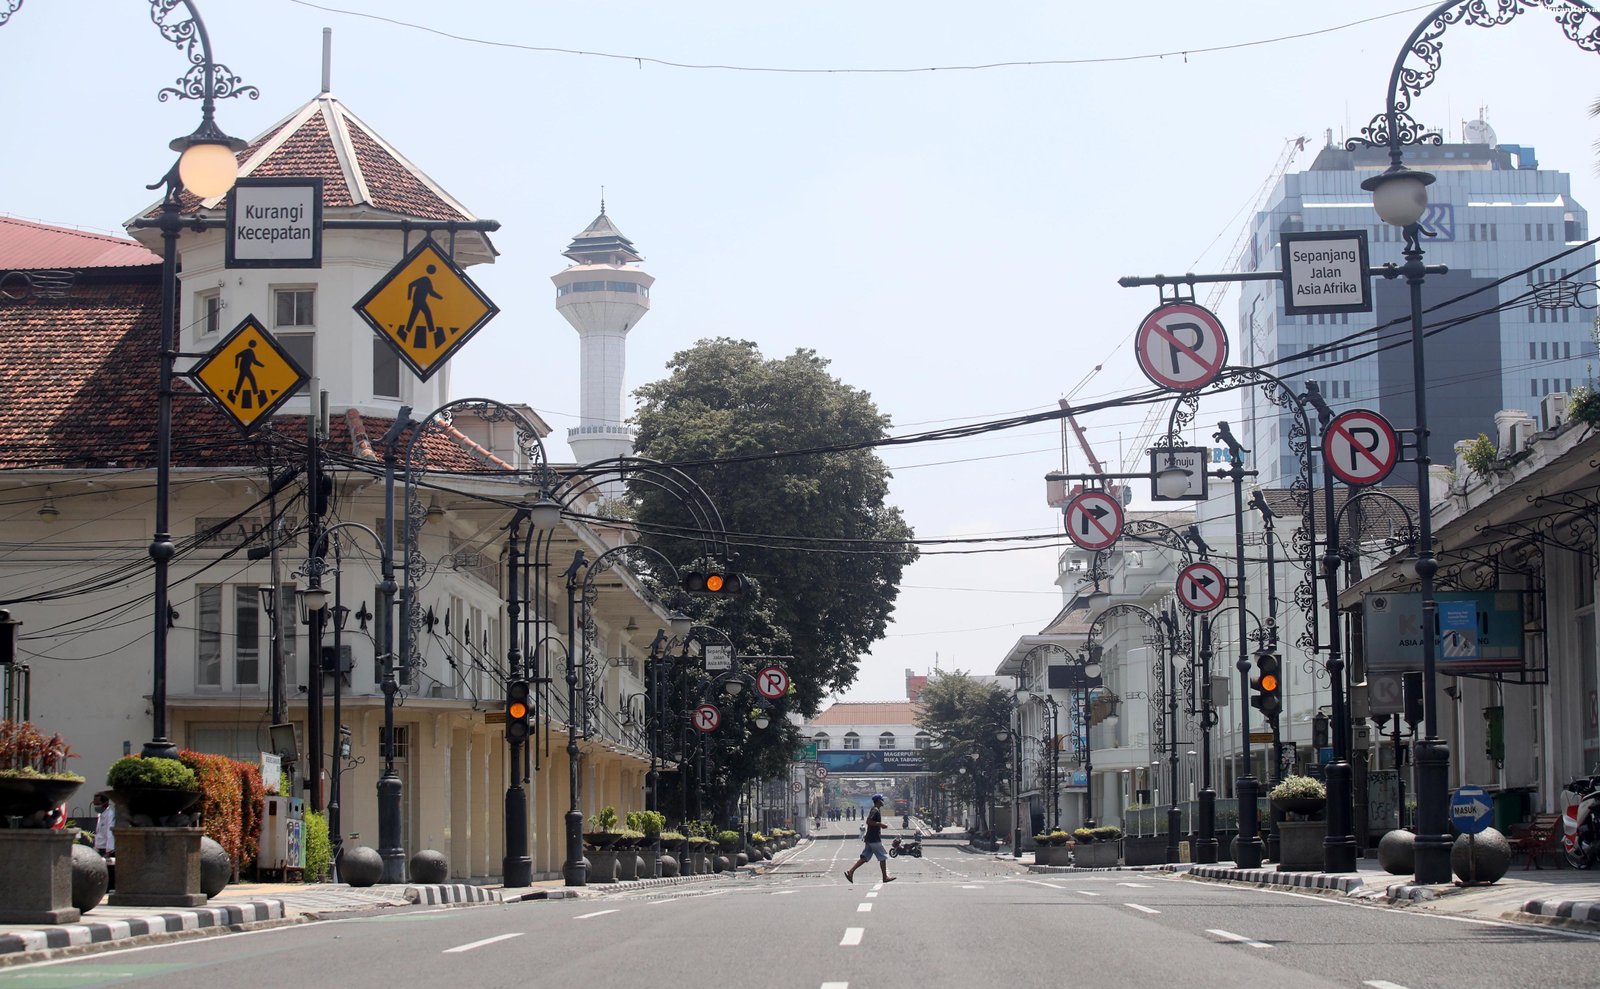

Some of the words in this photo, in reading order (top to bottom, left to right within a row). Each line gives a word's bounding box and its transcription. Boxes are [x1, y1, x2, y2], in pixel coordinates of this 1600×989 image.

[246, 203, 303, 222] Kurangi
[238, 225, 311, 243] Kecepatan
[1293, 249, 1356, 264] Sepanjang
[1310, 267, 1341, 278] Jalan
[1297, 283, 1321, 295] Asia
[1323, 282, 1357, 294] Afrika
[1166, 322, 1204, 375] P
[1348, 426, 1380, 471] P
[1164, 457, 1194, 468] Mnuju
[767, 674, 781, 692] P
[702, 710, 713, 726] P
[1454, 806, 1477, 814] MASUK
